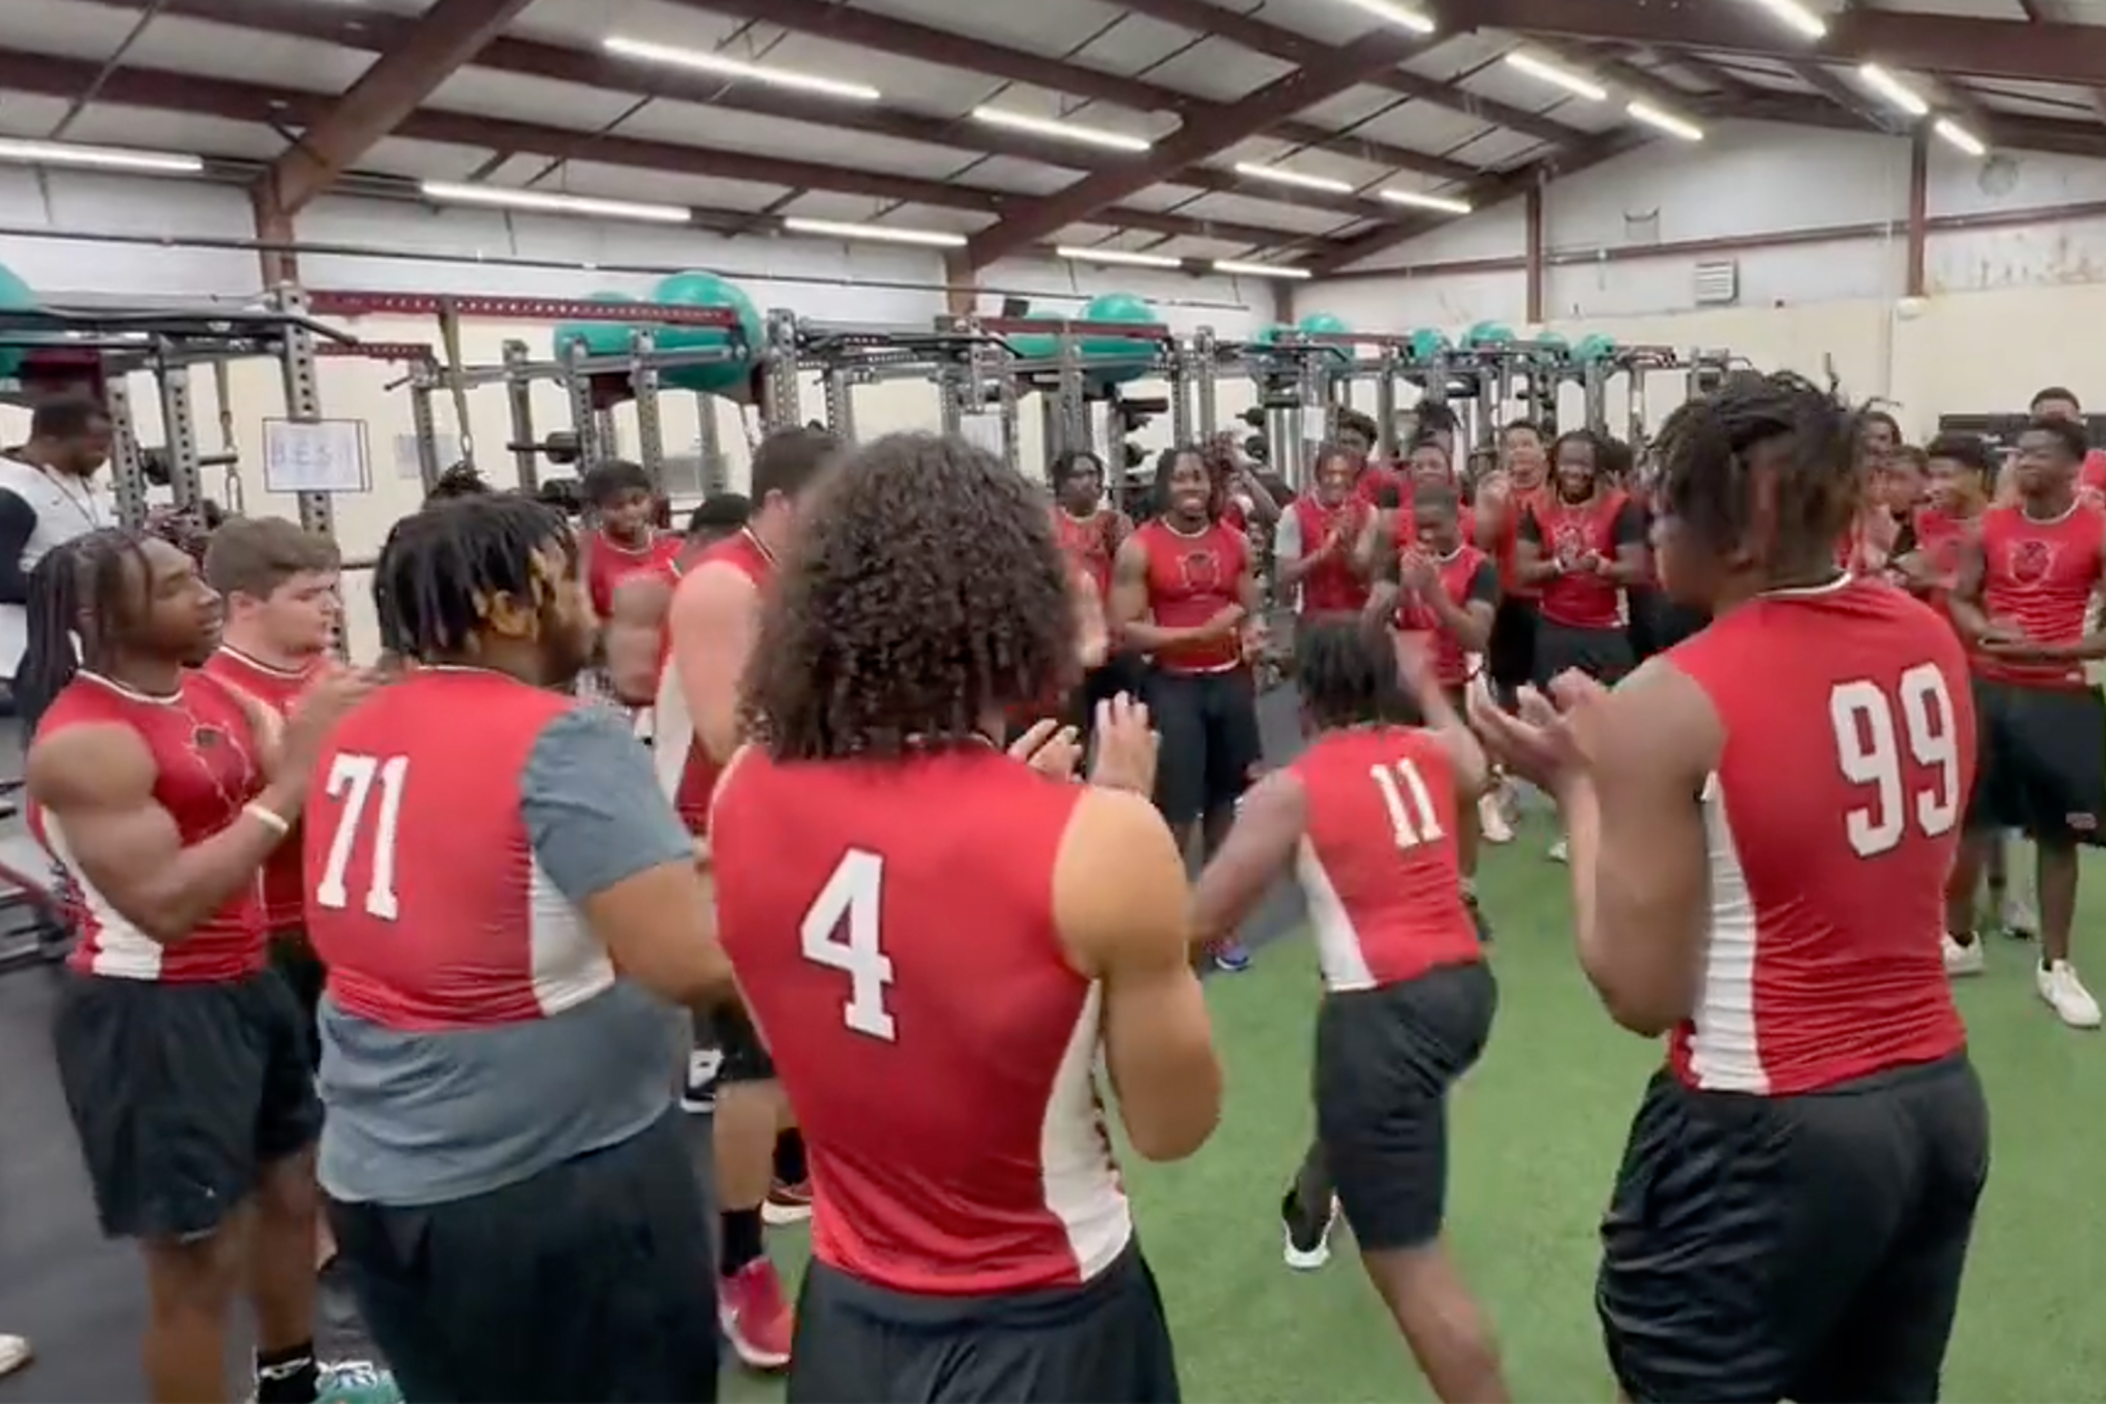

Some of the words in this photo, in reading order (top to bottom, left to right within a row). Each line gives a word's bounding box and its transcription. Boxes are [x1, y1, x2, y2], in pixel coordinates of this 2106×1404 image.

[317, 753, 409, 920] 71
[1370, 757, 1445, 848] 11
[1830, 662, 1960, 857] 99
[801, 847, 896, 1041] 4
